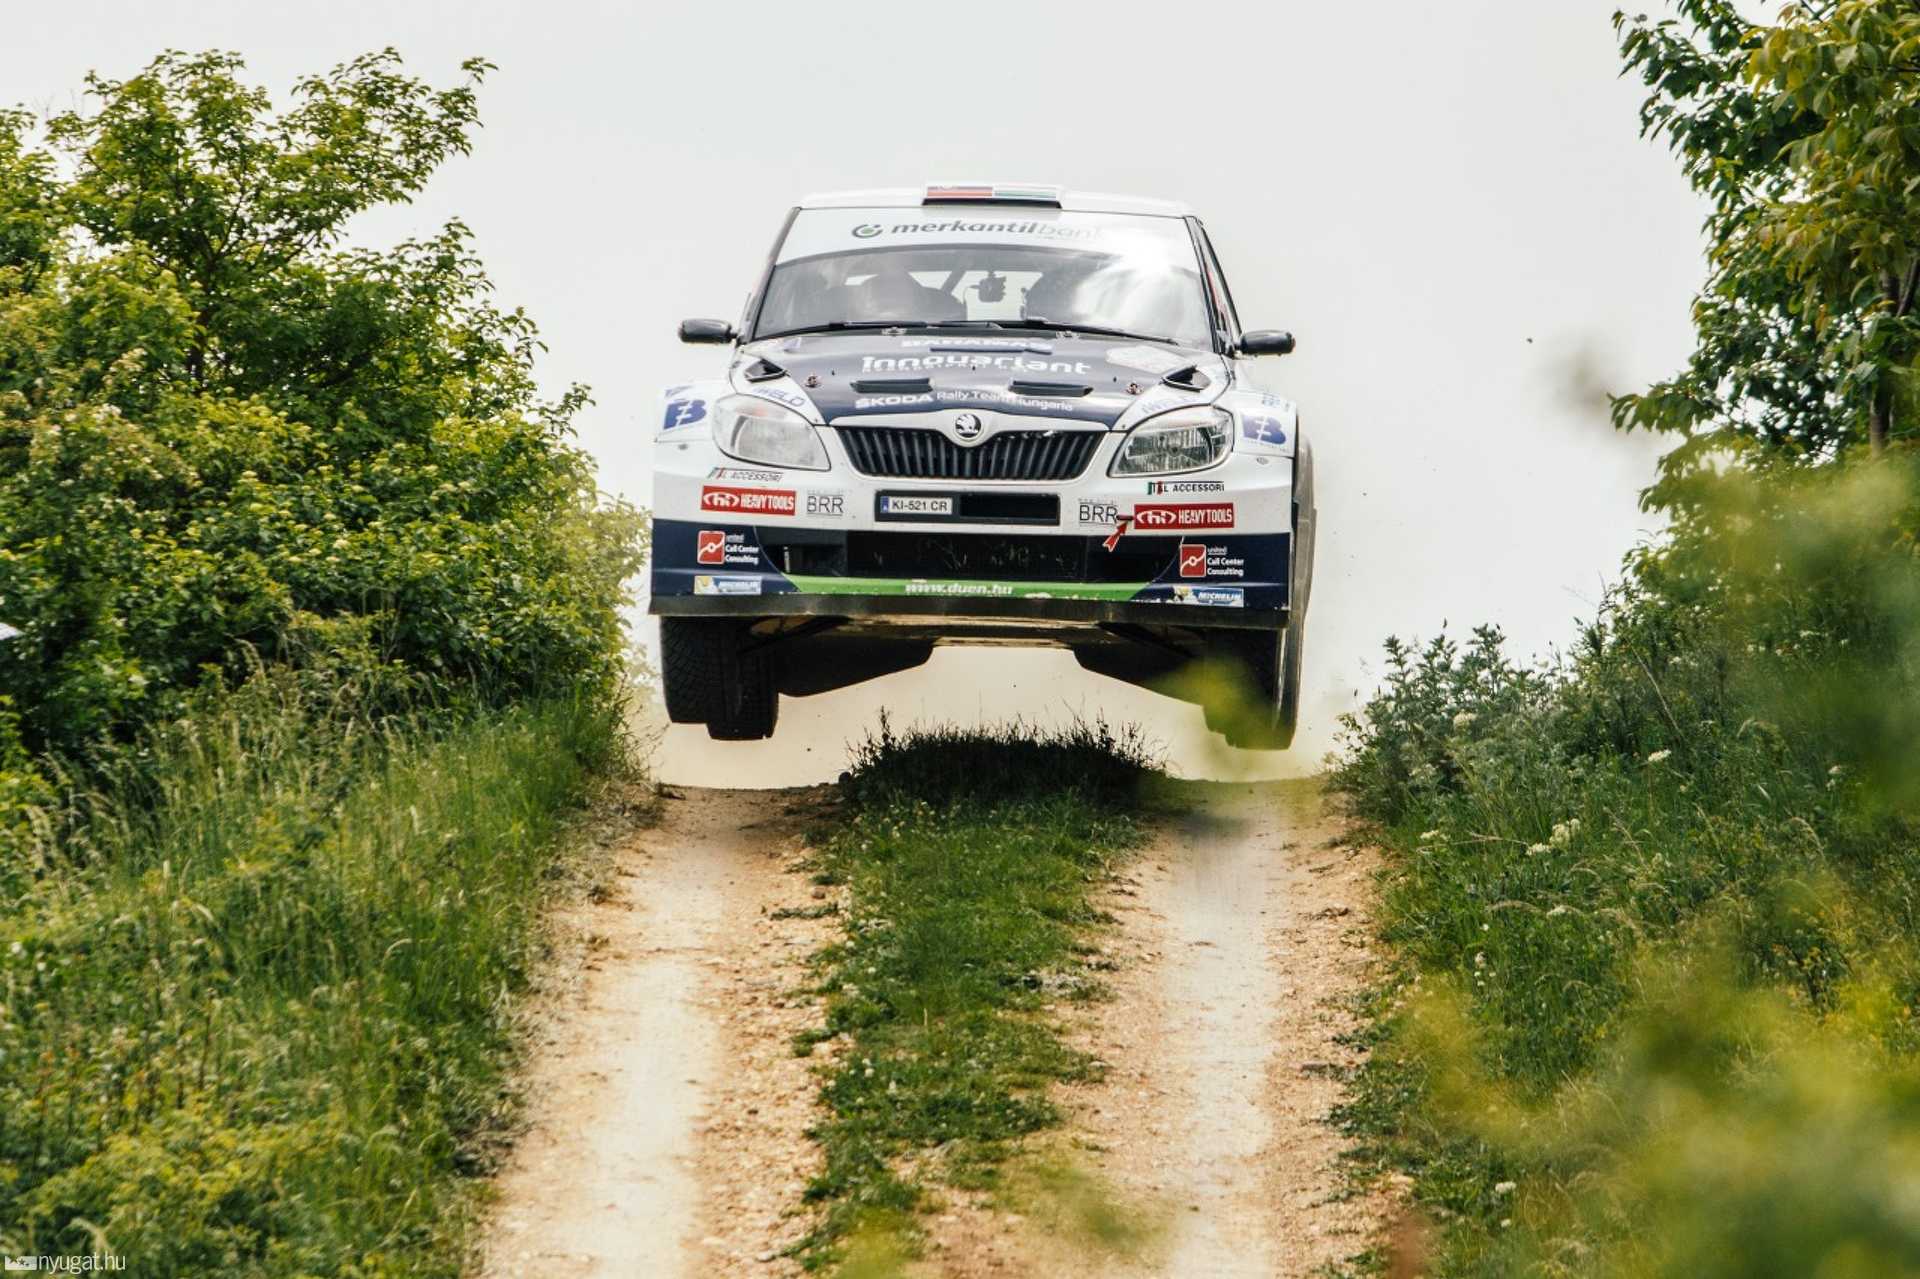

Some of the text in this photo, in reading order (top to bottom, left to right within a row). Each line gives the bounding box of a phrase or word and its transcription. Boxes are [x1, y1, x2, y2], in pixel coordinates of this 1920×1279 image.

[937, 391, 970, 401] Rally
[973, 391, 1006, 401] Team
[1172, 484, 1224, 493] ACCESSORI
[740, 493, 767, 509] HEAVY
[768, 495, 794, 511] TOOLS
[807, 496, 844, 513] BRR
[892, 499, 948, 511] KI-521 CR
[1080, 504, 1118, 523] BRR
[1179, 510, 1206, 525] HEAVY
[1206, 509, 1232, 523] TOOLS
[739, 545, 759, 553] Center
[1207, 557, 1244, 566] Call Center
[1207, 567, 1244, 577] Consulting
